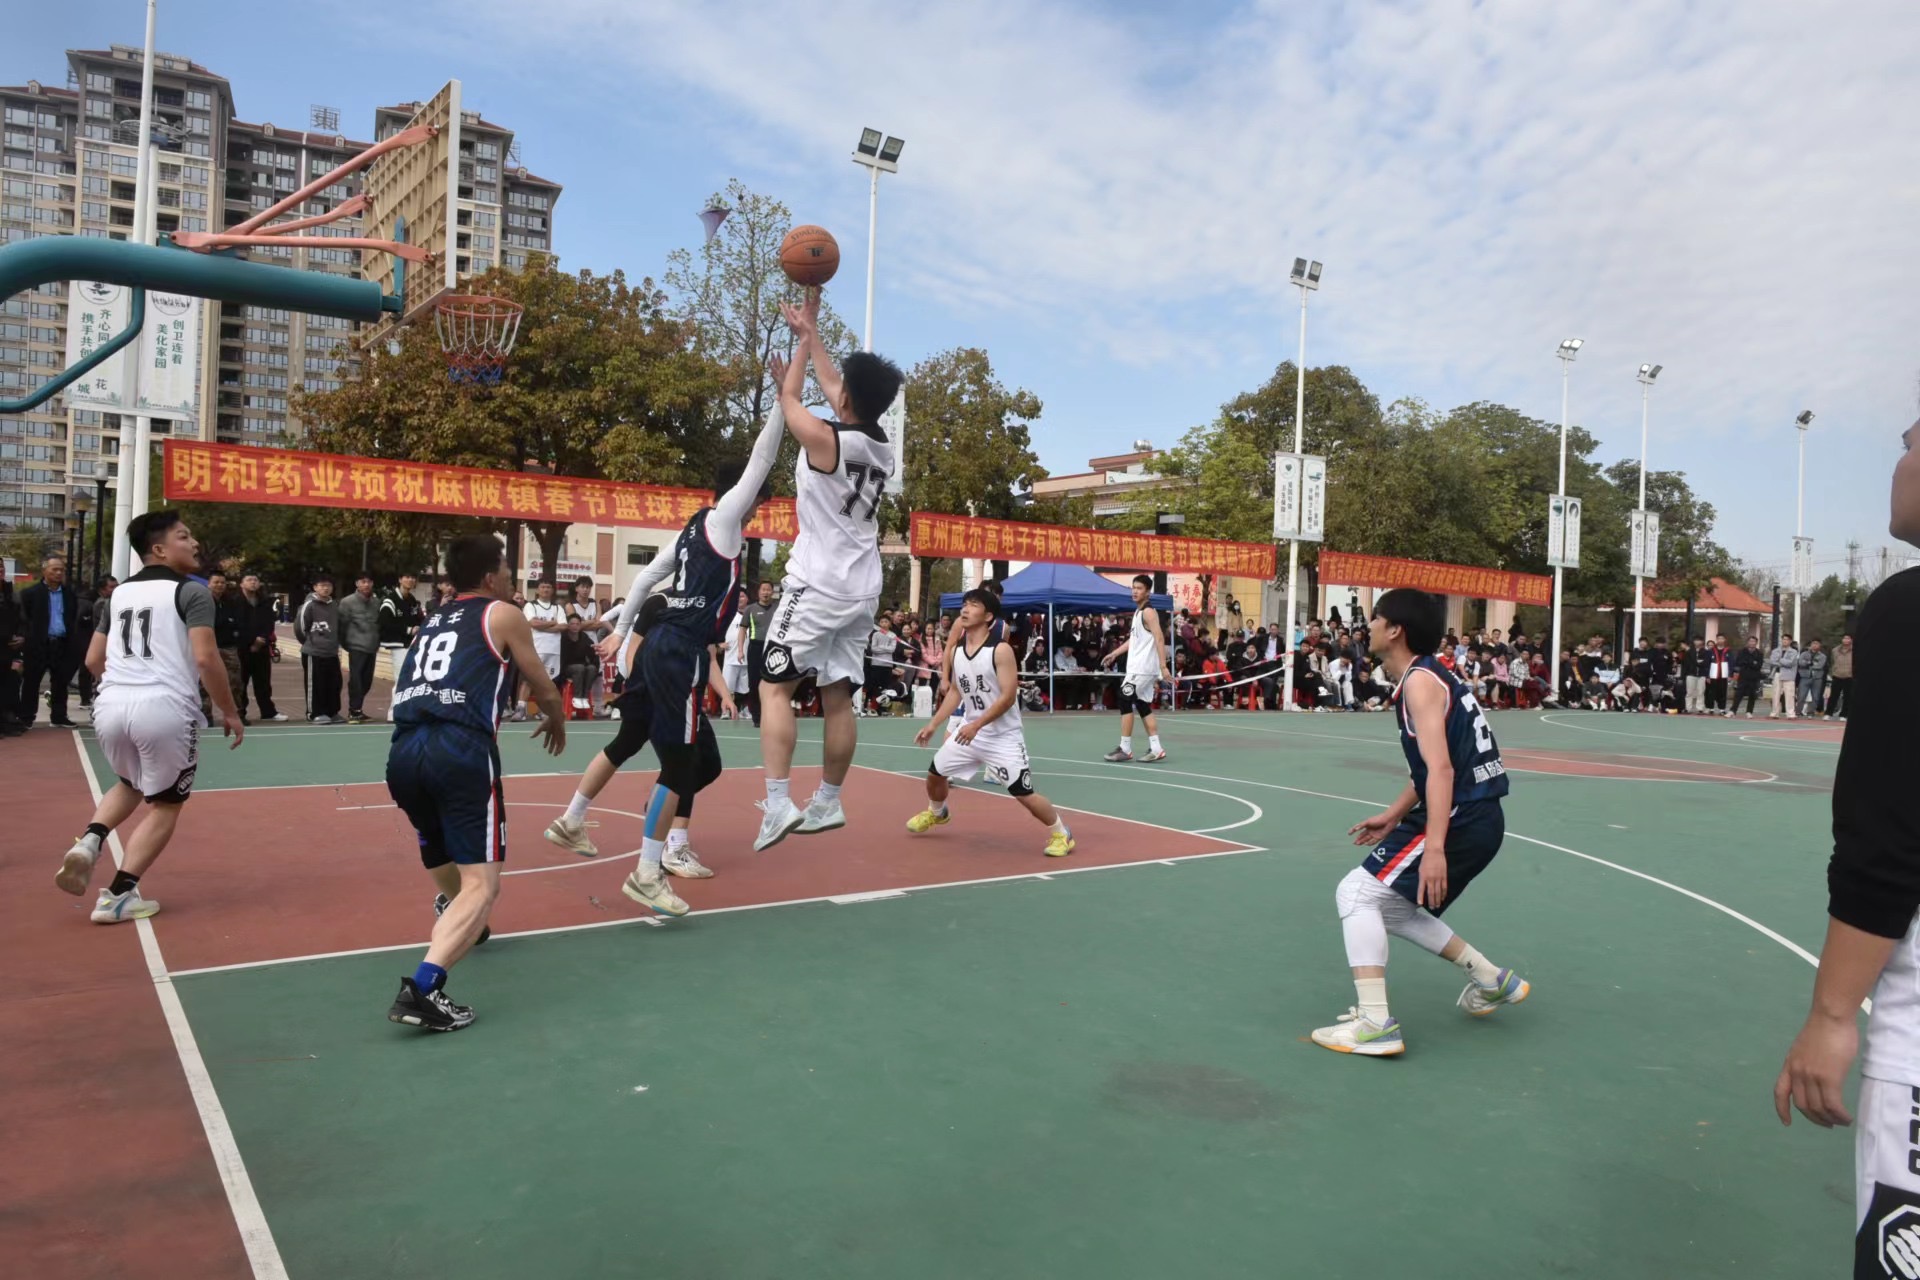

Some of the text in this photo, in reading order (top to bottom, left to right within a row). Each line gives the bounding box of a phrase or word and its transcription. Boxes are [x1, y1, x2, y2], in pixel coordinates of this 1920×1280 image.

[155, 323, 168, 369] 美化家园
[839, 460, 887, 522] 77
[118, 606, 154, 660] 11
[412, 631, 459, 682] 18
[970, 695, 985, 711] 19
